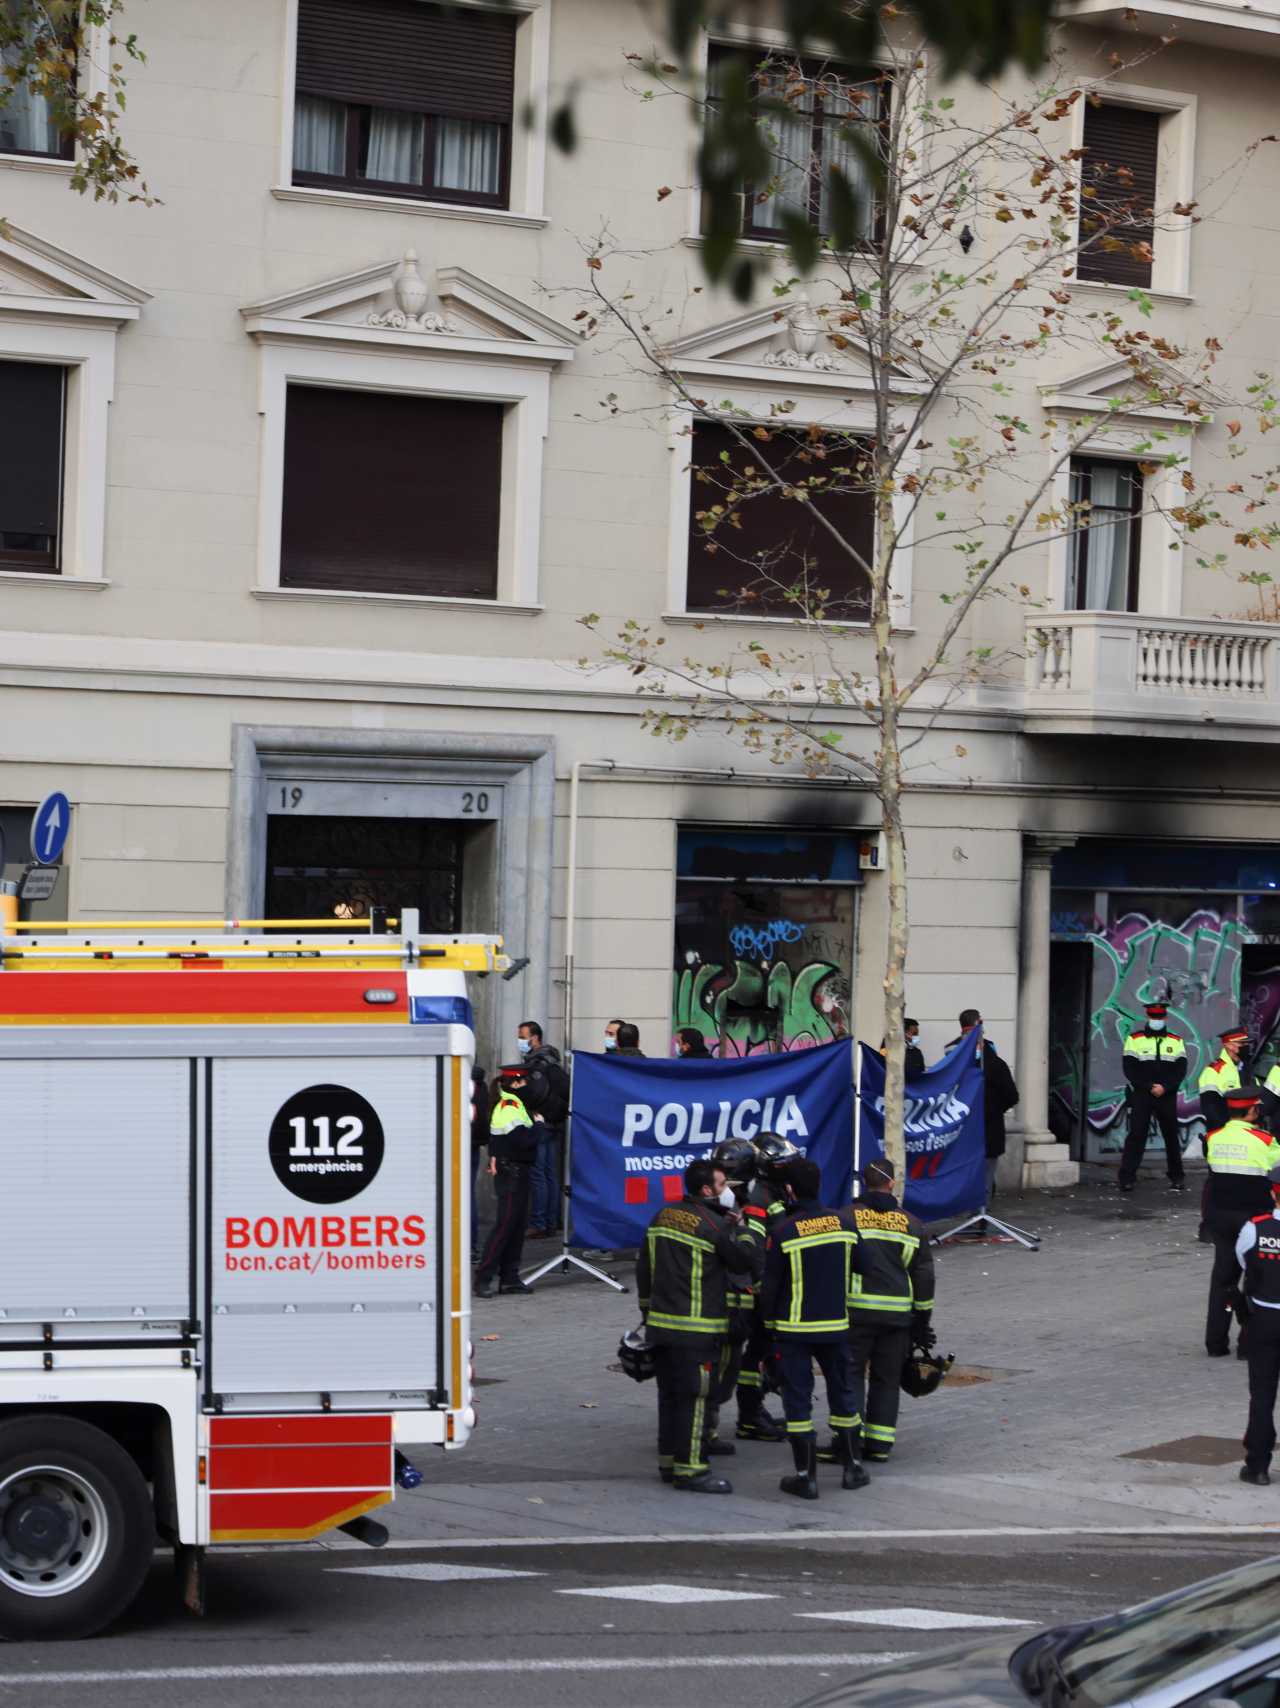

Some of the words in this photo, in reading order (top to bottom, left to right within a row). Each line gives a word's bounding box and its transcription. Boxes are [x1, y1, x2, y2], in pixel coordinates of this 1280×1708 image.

[280, 787, 303, 809] 19
[462, 792, 489, 813] 20
[622, 1094, 809, 1147] POLICIA
[289, 1116, 364, 1156] 112
[289, 1160, 364, 1174] emergències
[795, 1216, 840, 1230] BOMBERS
[854, 1208, 908, 1224] BOMBERS
[225, 1215, 426, 1249] BOMBERS
[225, 1250, 426, 1275] bcn.cat/bombers
